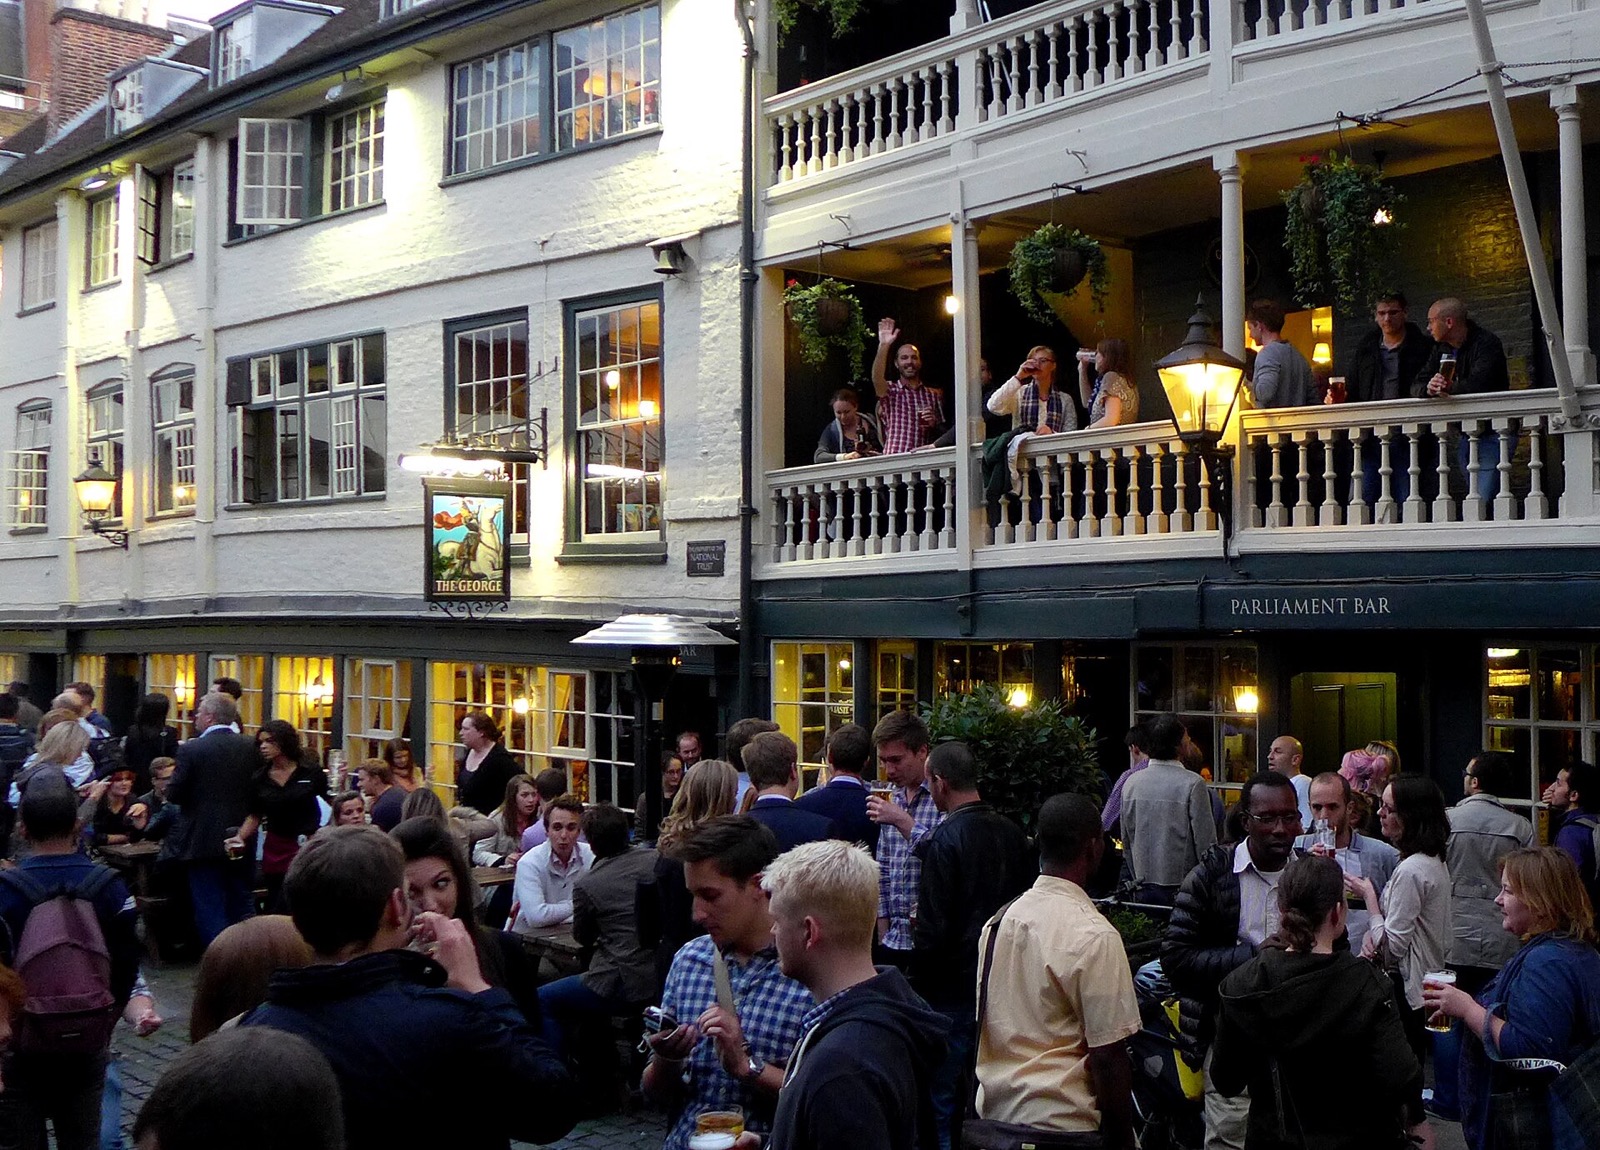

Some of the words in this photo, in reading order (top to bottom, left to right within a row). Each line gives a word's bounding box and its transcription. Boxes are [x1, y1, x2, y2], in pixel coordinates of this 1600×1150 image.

[690, 553, 720, 561] NATIONAL
[696, 562, 714, 570] TRUST
[435, 580, 456, 592] THE
[458, 580, 503, 592] GEORGE
[1230, 598, 1348, 615] PARLIAMENT
[1353, 597, 1391, 614] BAR
